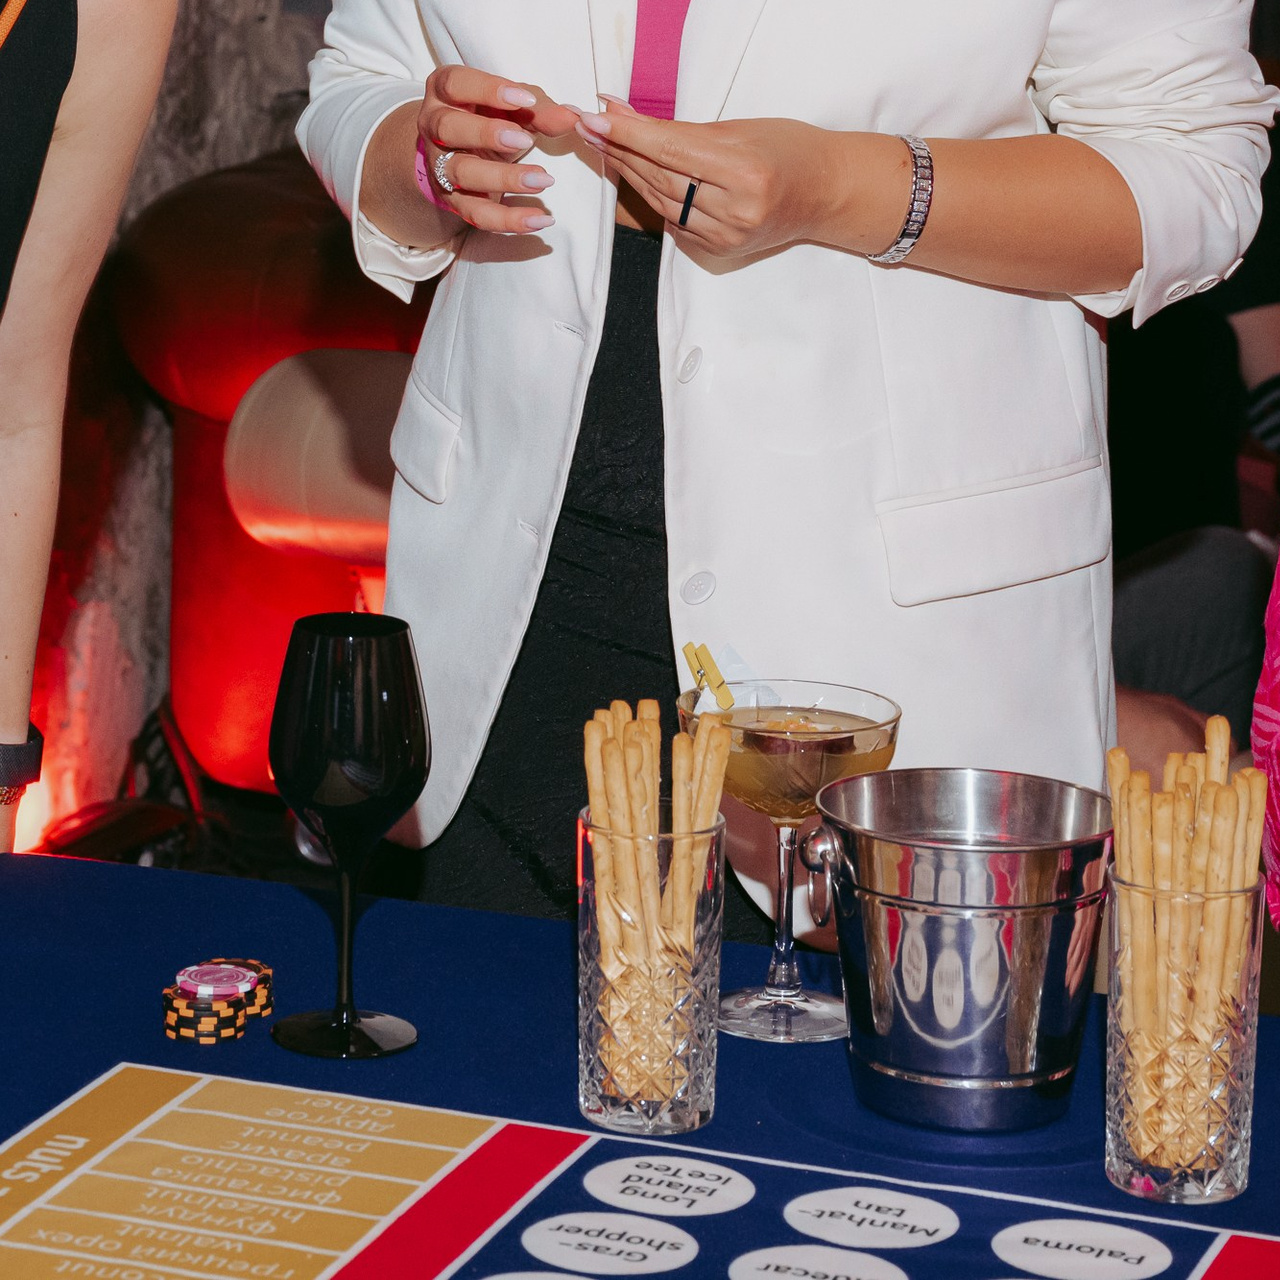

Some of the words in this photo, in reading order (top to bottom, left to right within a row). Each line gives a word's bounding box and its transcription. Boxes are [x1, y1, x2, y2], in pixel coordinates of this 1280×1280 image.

[264, 1107, 396, 1134] другое
[294, 1097, 394, 1118] other
[239, 1125, 372, 1153] peanut
[1, 1133, 91, 1183] nuts
[220, 1140, 352, 1168] арахис
[181, 1154, 354, 1188] pistachio
[621, 1173, 719, 1197] Island
[150, 1166, 343, 1206] фисташка
[618, 1185, 699, 1209] Long
[136, 1202, 277, 1236] фундук
[852, 1199, 907, 1218] tan
[798, 1208, 941, 1238] Manhat-
[28, 1227, 119, 1253] орех
[116, 1224, 245, 1254] walnut
[548, 1223, 686, 1252] shopper
[1022, 1236, 1147, 1265] Paloma
[129, 1243, 296, 1280] грецкий
[558, 1241, 649, 1263] Gras-
